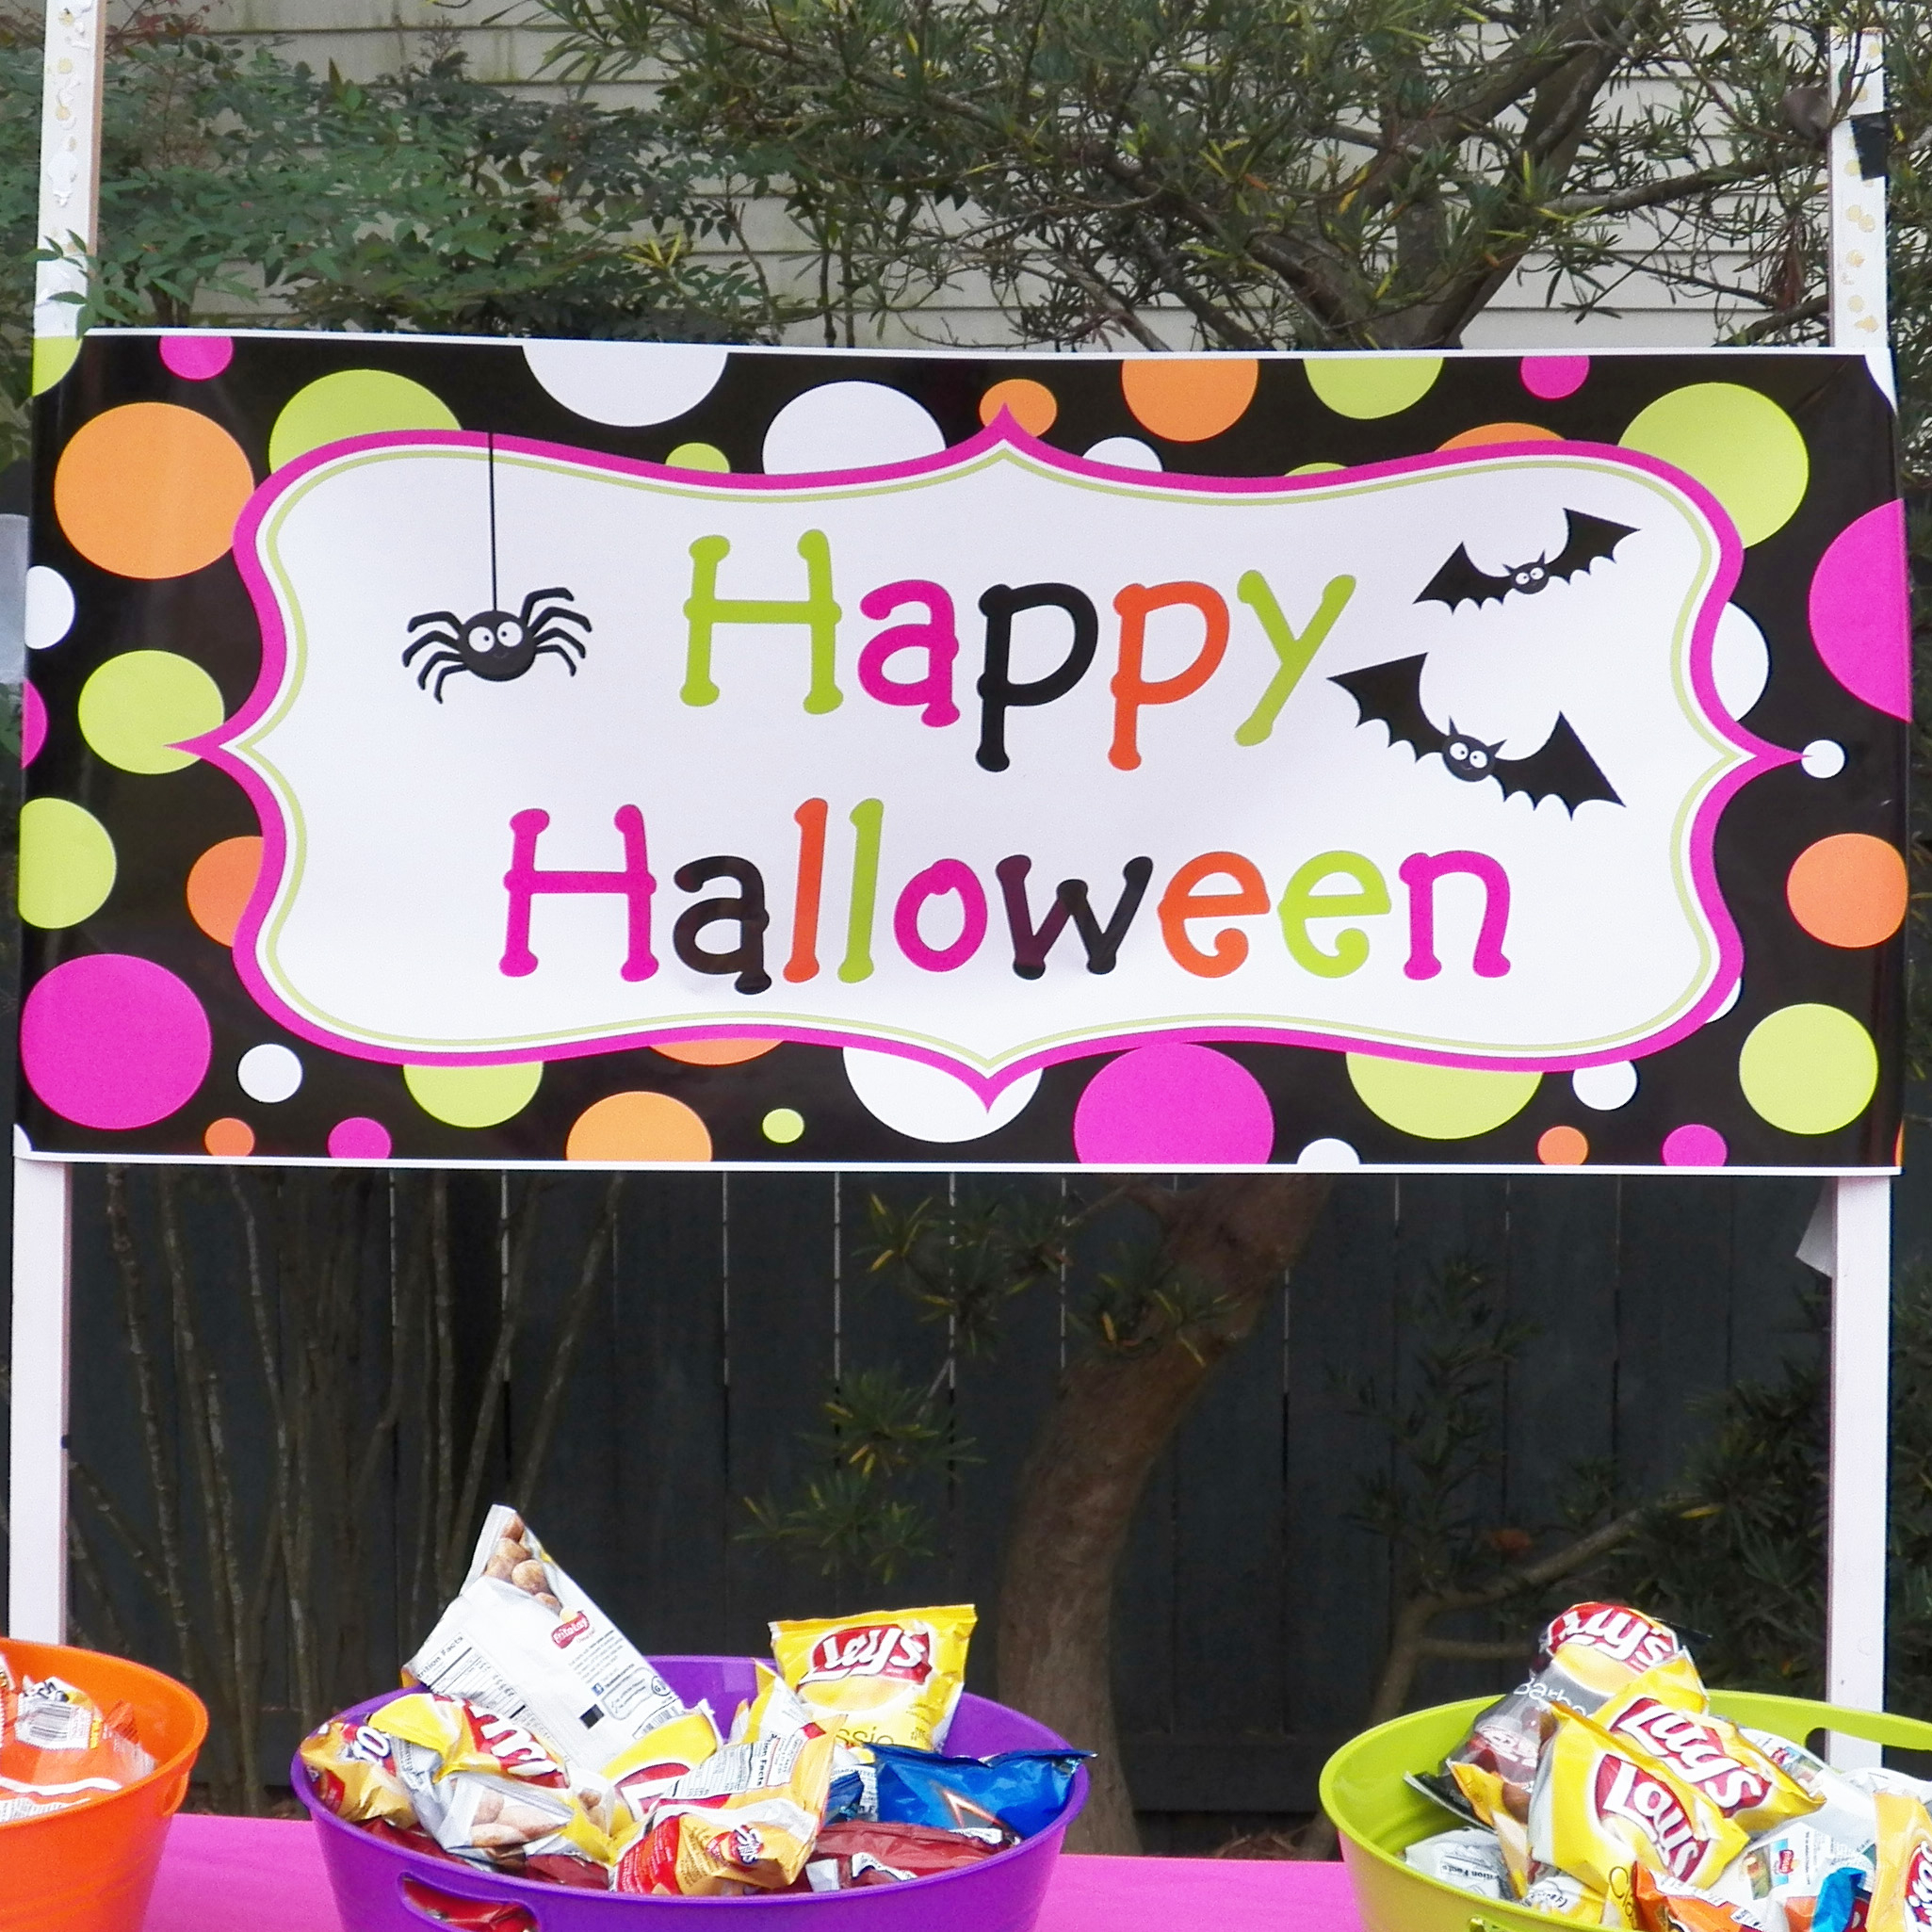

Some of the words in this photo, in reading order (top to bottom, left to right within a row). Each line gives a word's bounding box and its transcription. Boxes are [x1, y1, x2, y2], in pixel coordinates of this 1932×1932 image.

[679, 528, 1356, 772] Happy
[497, 797, 1513, 995] Halloween
[822, 1628, 927, 1676] Lay's
[1617, 1704, 1762, 1809] Lay's
